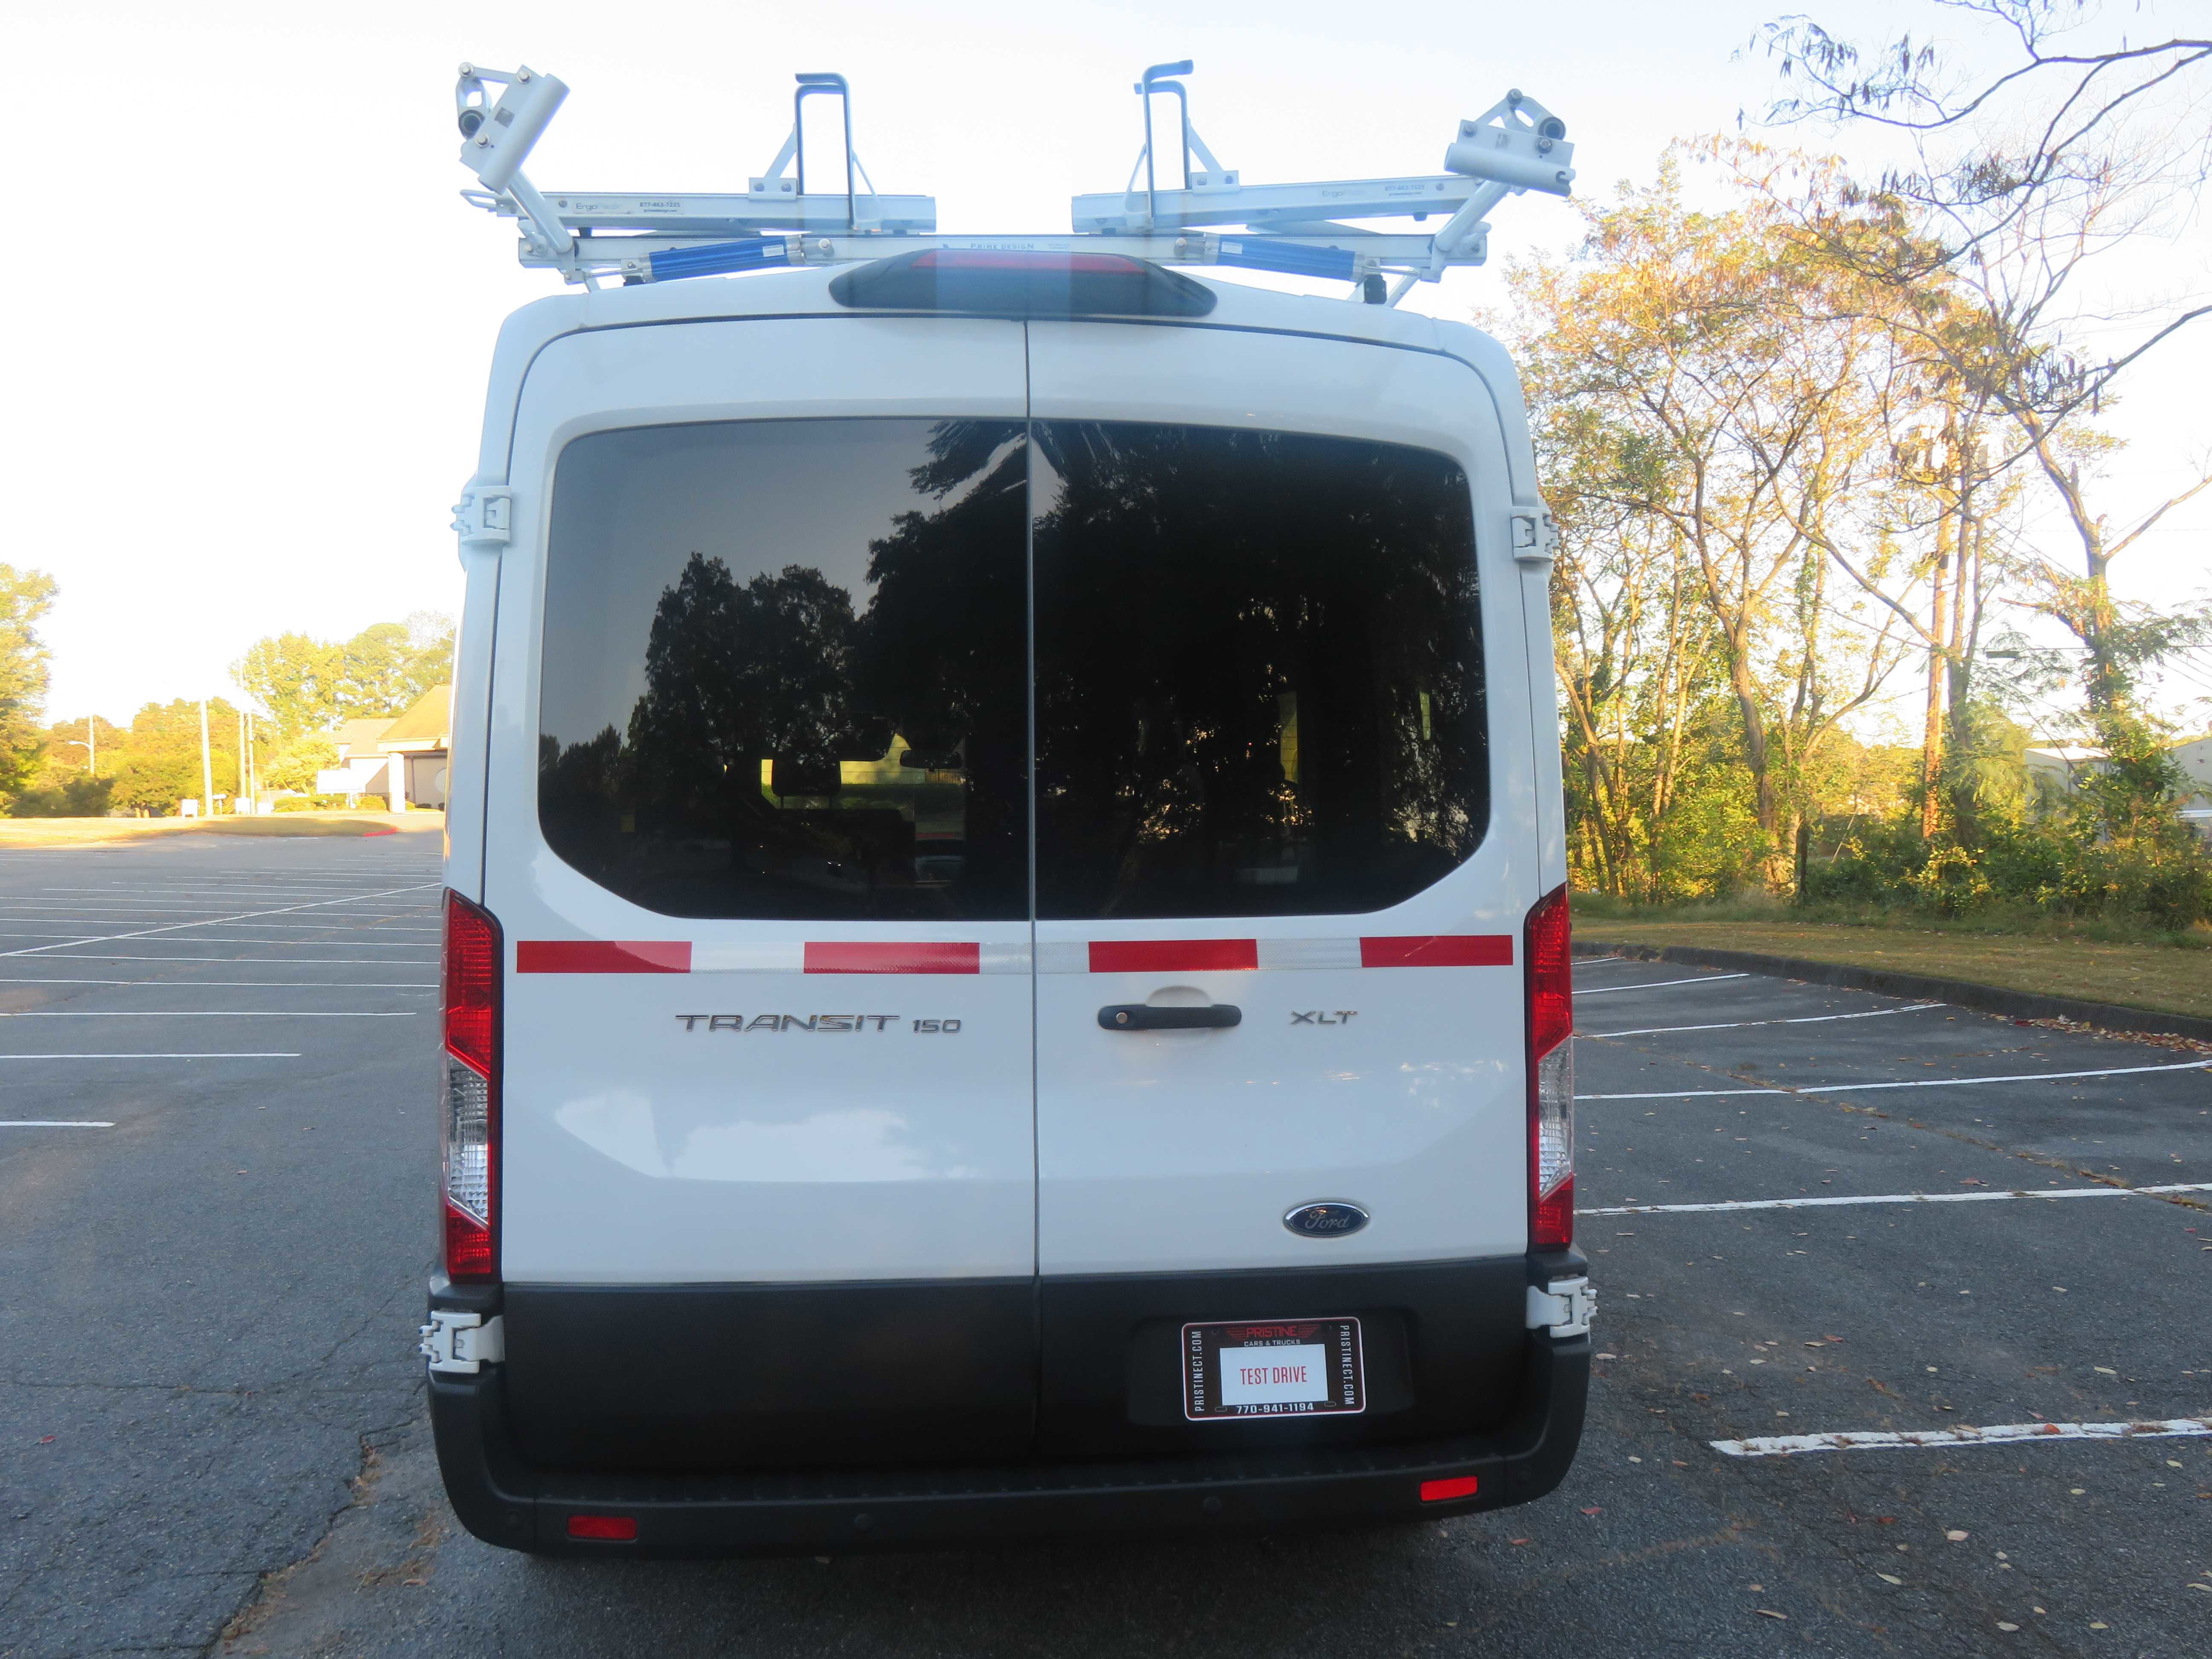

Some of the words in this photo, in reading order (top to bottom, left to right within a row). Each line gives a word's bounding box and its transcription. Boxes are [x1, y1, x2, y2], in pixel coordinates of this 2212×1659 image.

[675, 1014, 900, 1032] TRANSIT
[912, 1019, 962, 1033] 150
[1290, 1010, 1358, 1025] XLT
[1305, 1208, 1349, 1230] Ford
[1246, 1325, 1298, 1338] PRISTINE
[1191, 1330, 1205, 1412] PRISTINECT.COM
[1340, 1324, 1355, 1406] PRISTINECT.COM
[1240, 1368, 1269, 1385] TEST
[1272, 1366, 1307, 1384] DRIVE
[1237, 1403, 1315, 1415] 770-941-1194
